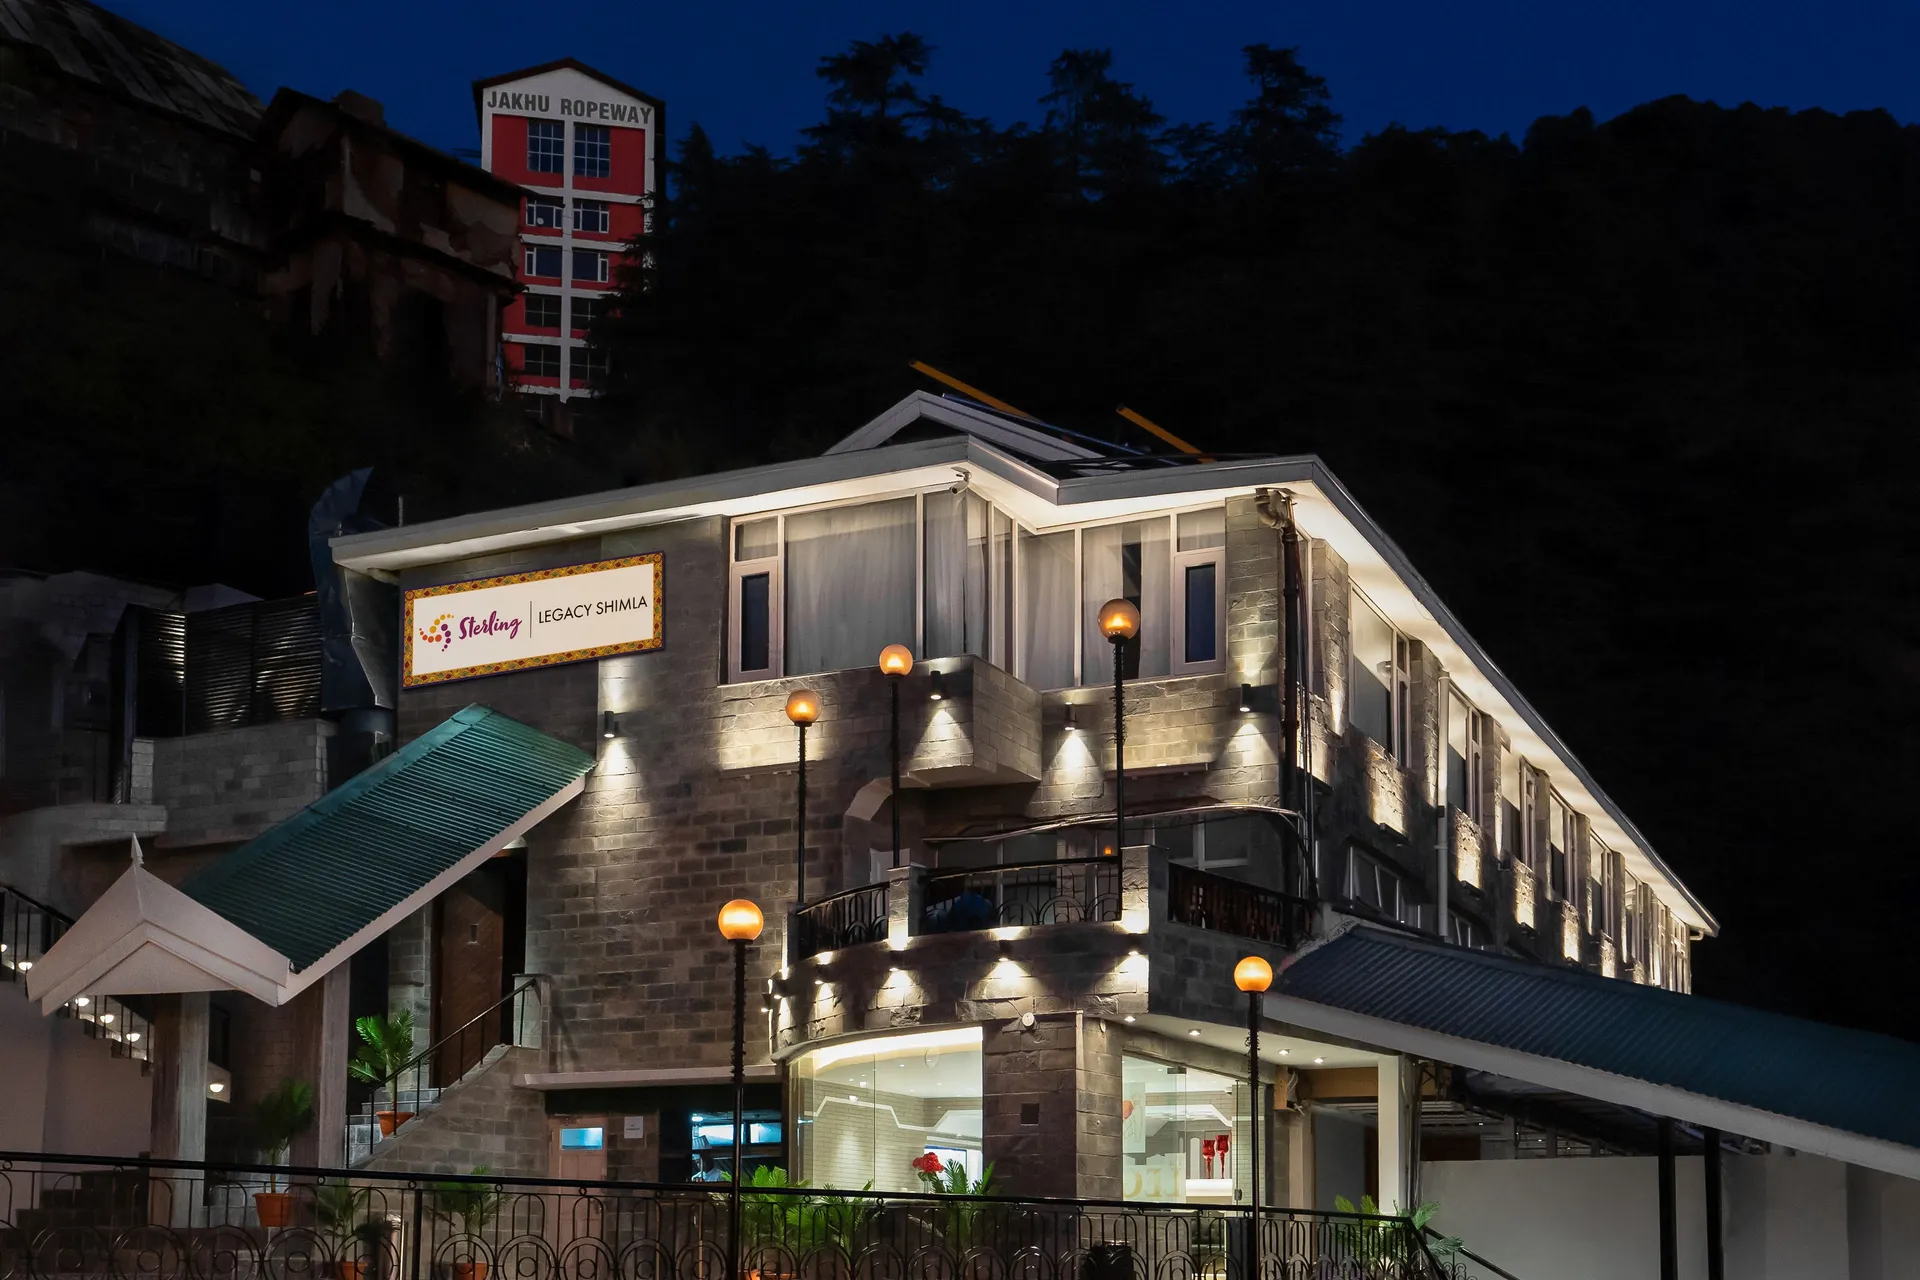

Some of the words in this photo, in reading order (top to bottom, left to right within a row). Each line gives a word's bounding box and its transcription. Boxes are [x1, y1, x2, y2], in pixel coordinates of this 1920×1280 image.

[487, 91, 550, 113] JAKHU
[560, 98, 653, 125] ROPEWAY
[538, 603, 592, 624] LEGACY
[595, 595, 648, 615] SHIMLA
[458, 610, 523, 640] Sterling
